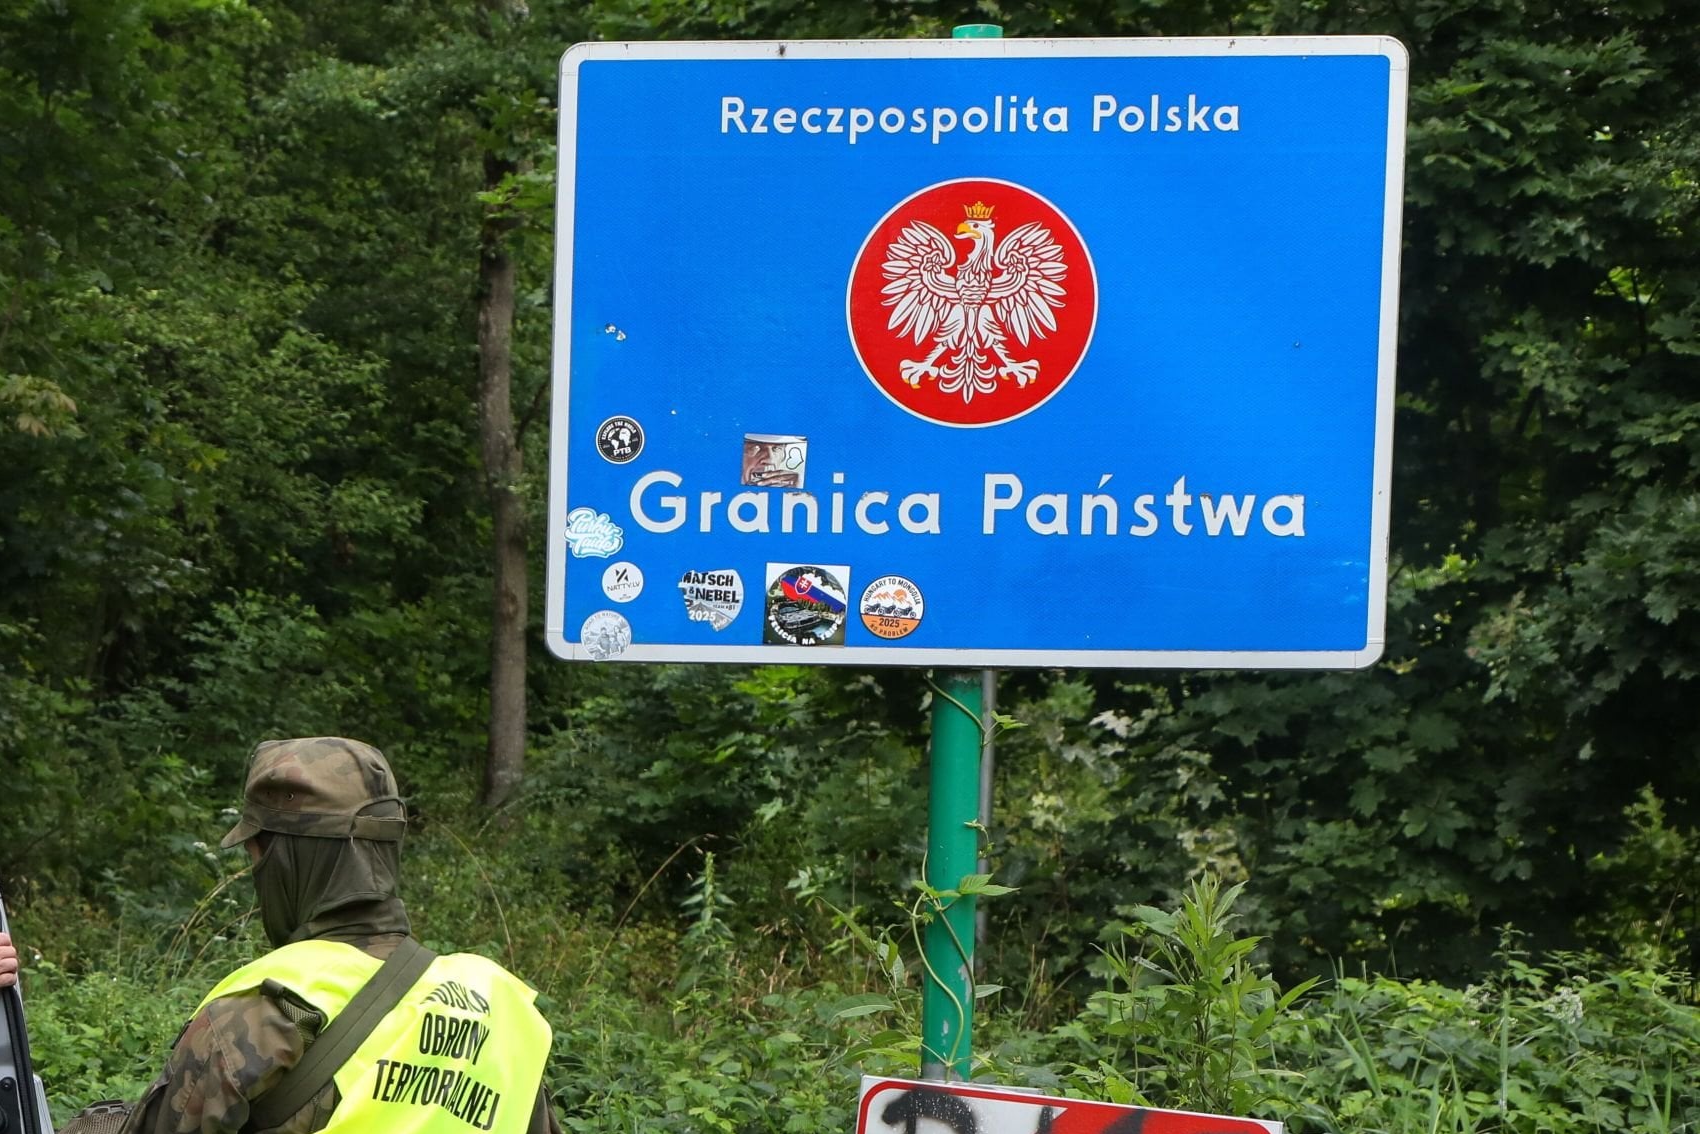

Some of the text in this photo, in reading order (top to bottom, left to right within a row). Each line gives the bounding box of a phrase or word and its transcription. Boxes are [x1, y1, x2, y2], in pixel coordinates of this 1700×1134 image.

[720, 94, 1240, 145] Rzeczpospolita Polska
[613, 446, 632, 456] PTB
[629, 470, 1307, 538] Granica Państwa
[606, 580, 641, 592] NATTY.LV
[863, 580, 887, 602] HUNGARY
[898, 578, 921, 605] MONGOLIA
[695, 587, 740, 604] NEBEL
[688, 610, 717, 622] 2025
[878, 617, 900, 628] 2025
[879, 626, 909, 637] PROBLEM
[802, 637, 816, 645] NA
[418, 1011, 491, 1066] OBRONY
